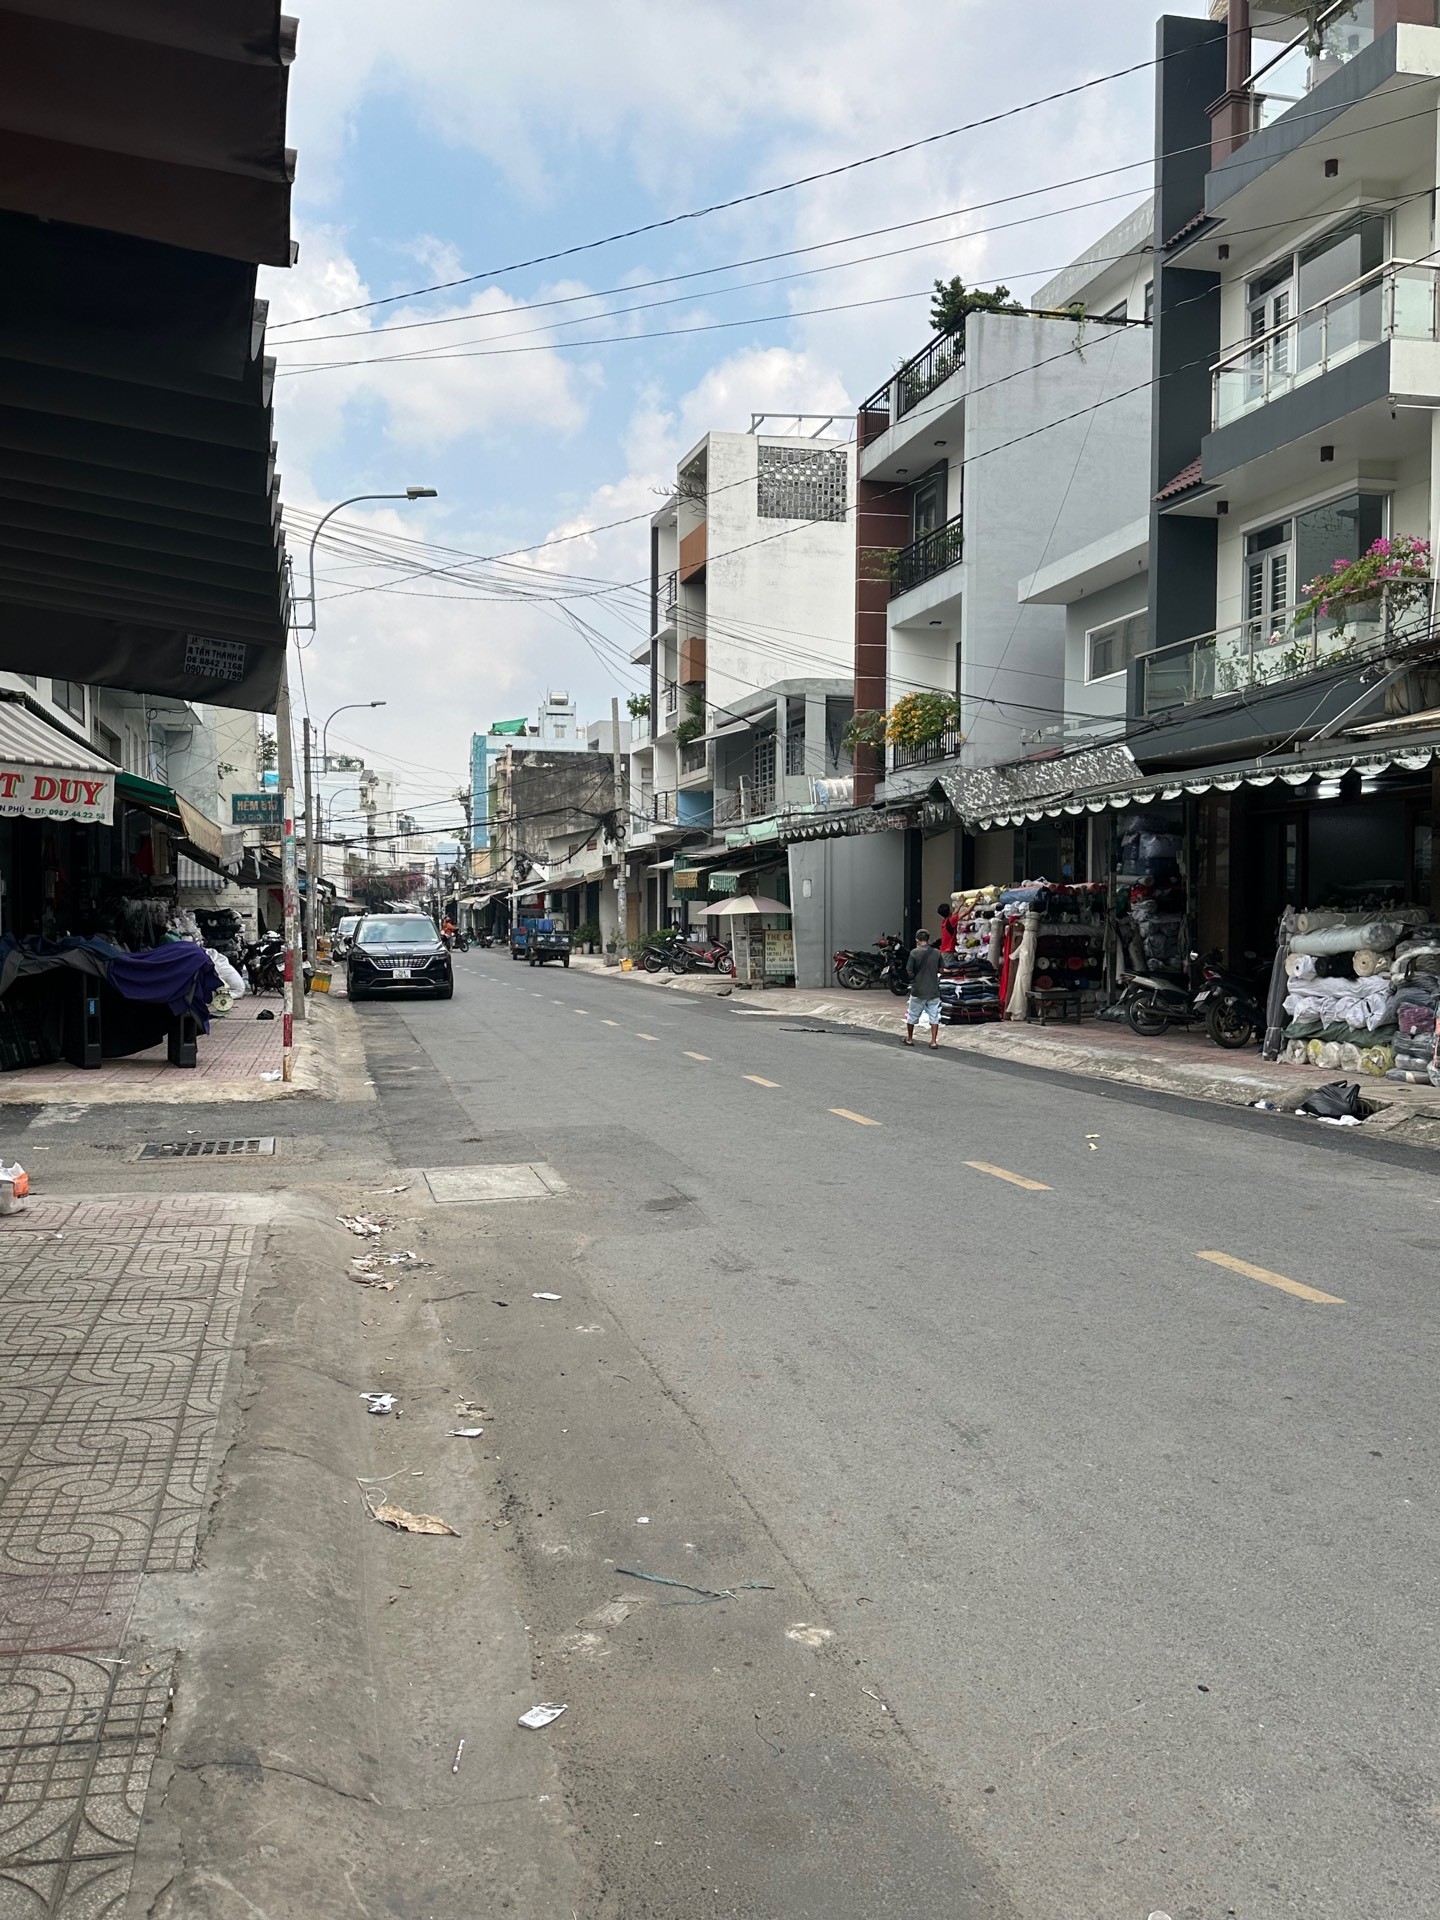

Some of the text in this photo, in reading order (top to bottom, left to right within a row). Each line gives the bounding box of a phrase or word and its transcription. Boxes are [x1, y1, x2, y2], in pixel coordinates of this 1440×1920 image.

[187, 655, 242, 671] 08 8842 1168
[185, 664, 242, 681] 0907 710 799
[31, 776, 107, 805] DUY
